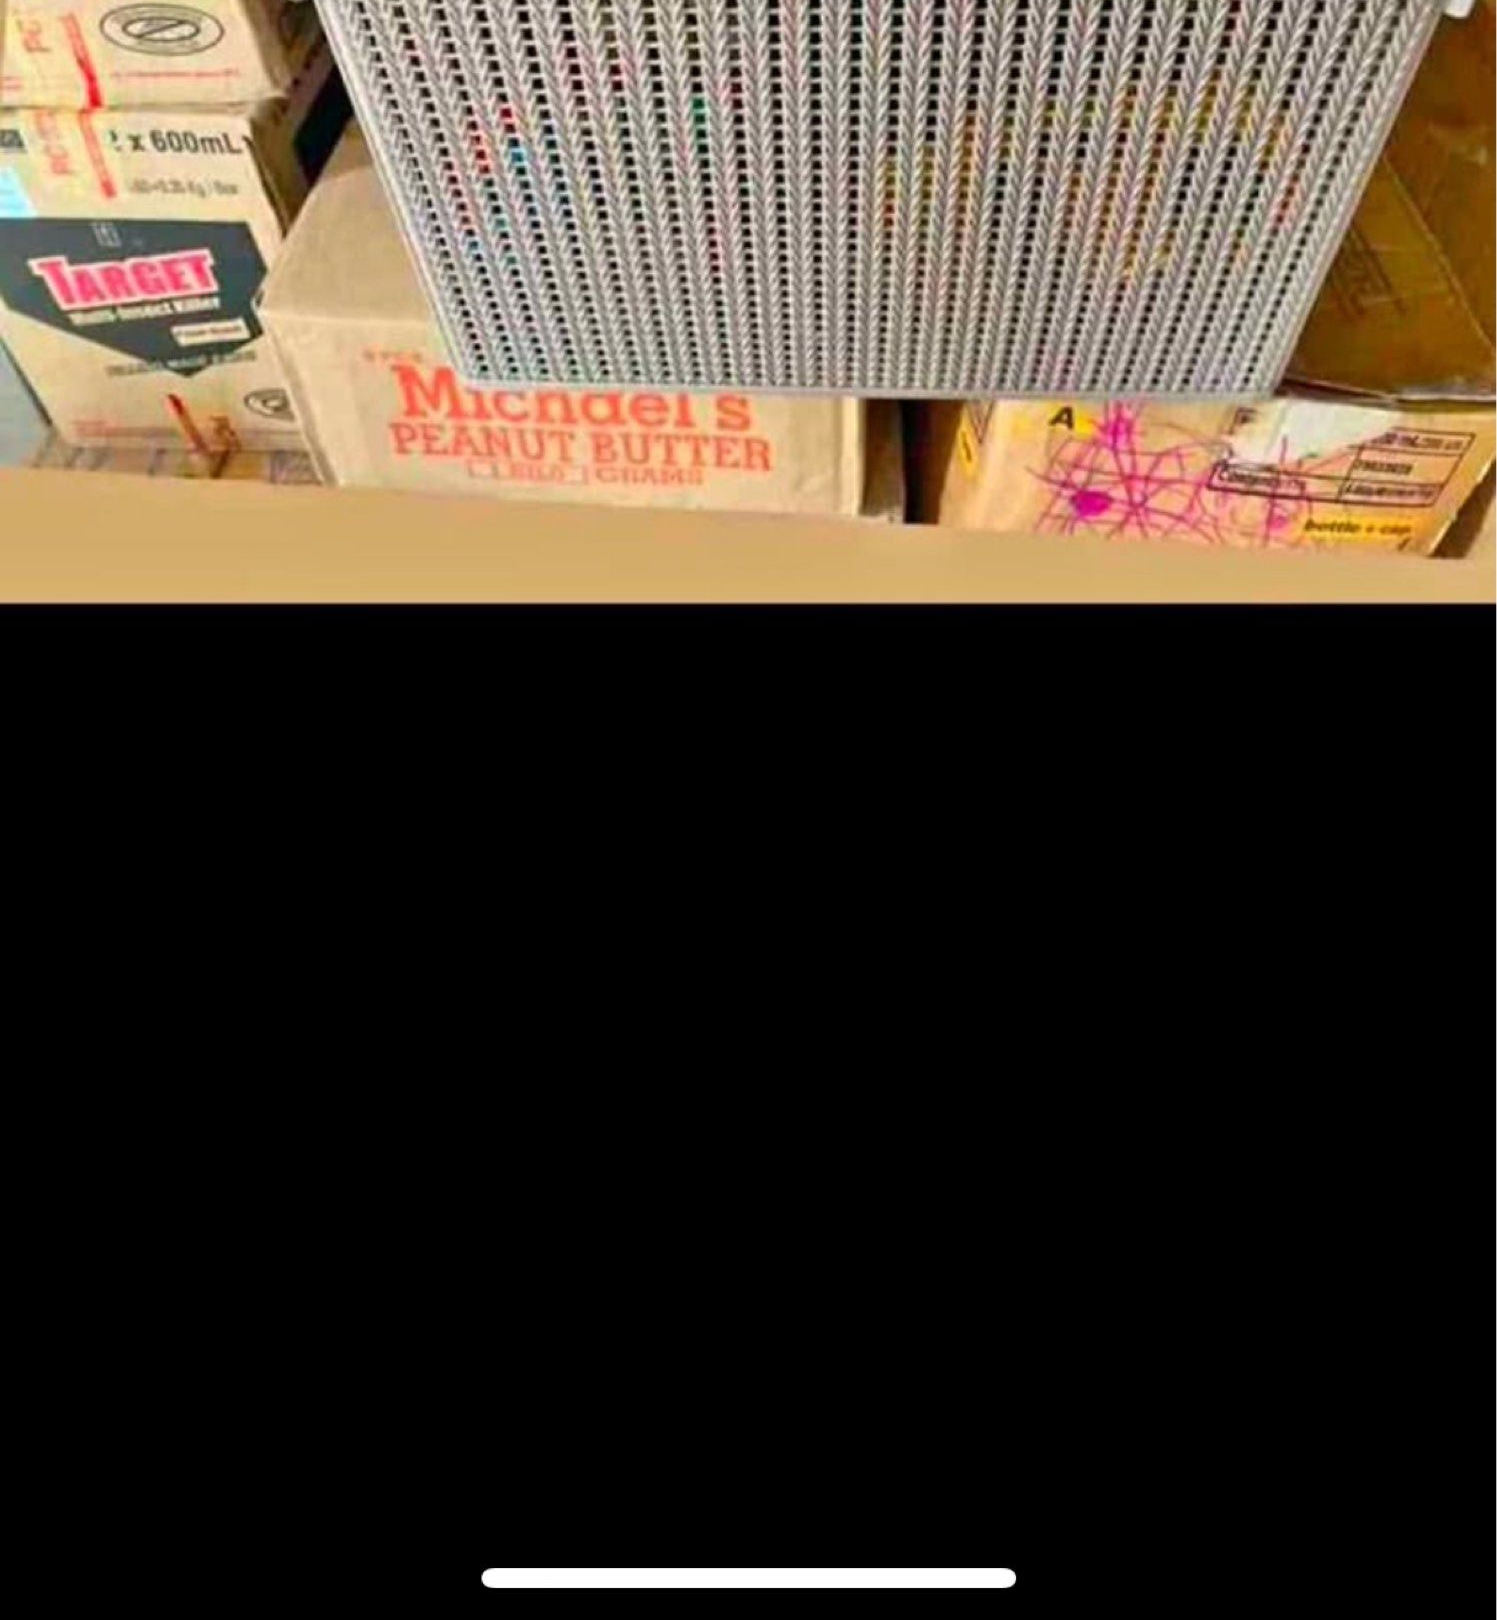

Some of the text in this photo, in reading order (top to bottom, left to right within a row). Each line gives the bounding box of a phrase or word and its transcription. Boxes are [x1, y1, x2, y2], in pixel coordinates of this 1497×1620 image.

[151, 129, 243, 155] 600mL
[28, 248, 219, 311] TARGET
[391, 365, 752, 432] Michaels
[1049, 406, 1075, 431] A
[388, 422, 773, 471] PEANUT BUTTER
